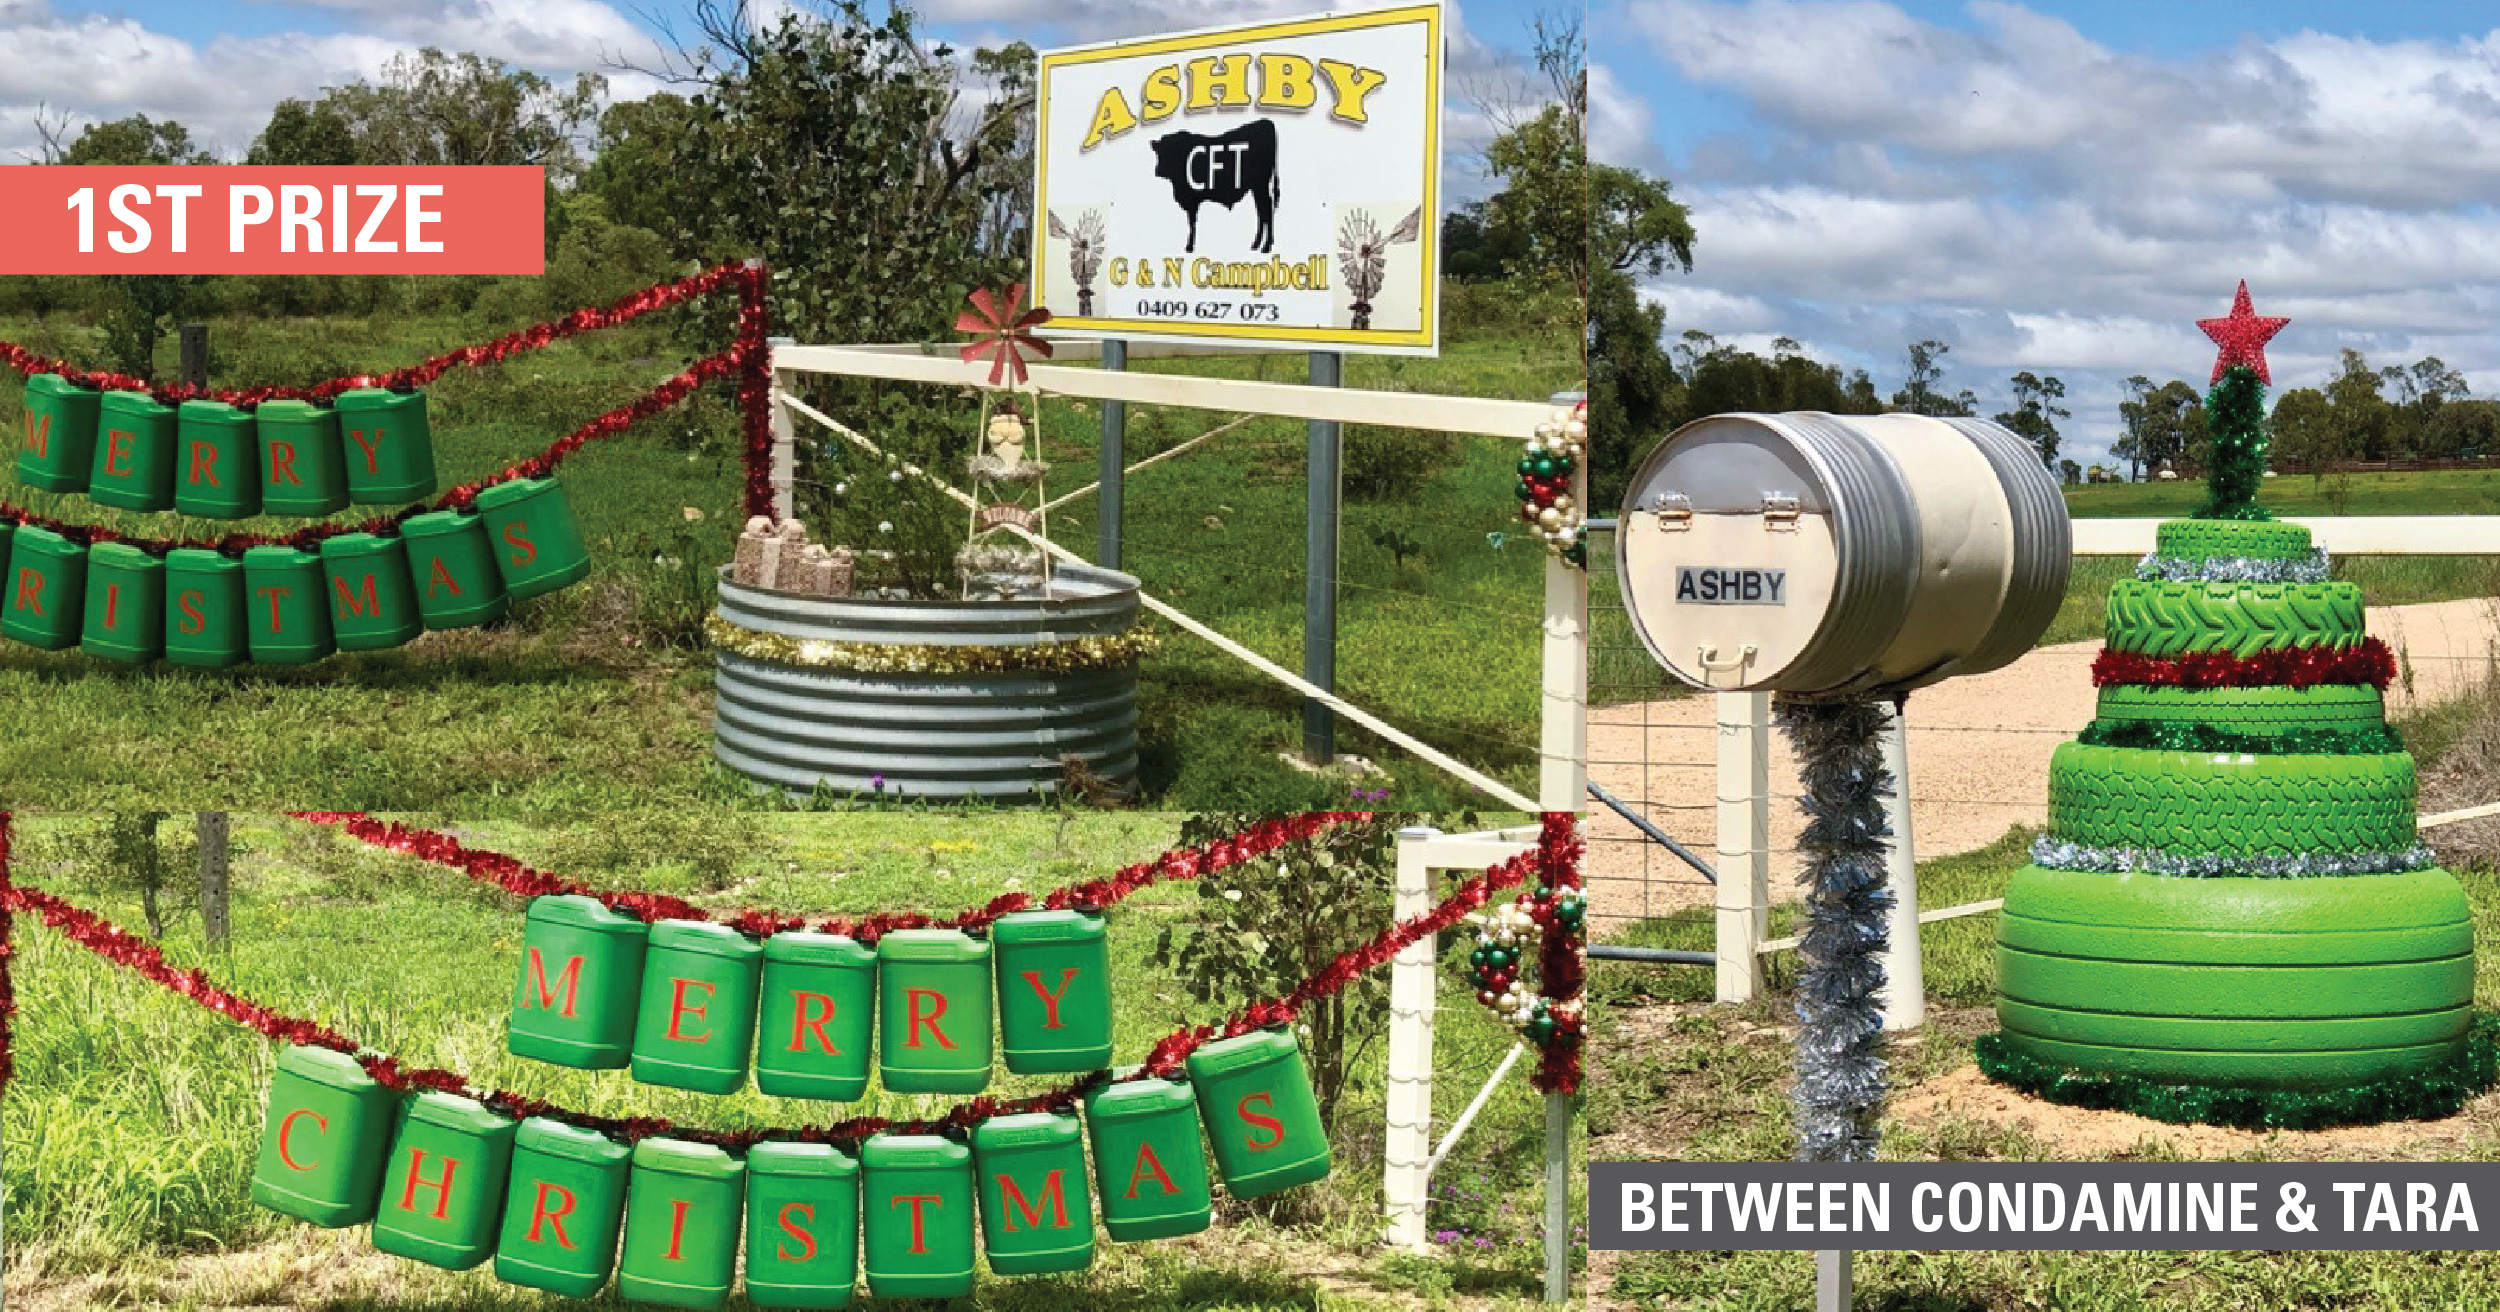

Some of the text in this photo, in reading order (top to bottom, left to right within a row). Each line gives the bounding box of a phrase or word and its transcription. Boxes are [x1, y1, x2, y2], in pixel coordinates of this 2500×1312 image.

[1082, 52, 1386, 150] ASHBY
[1185, 143, 1249, 190] CFT
[1109, 254, 1330, 297] G & N Campbell
[1137, 299, 1280, 321] 0409 627 073
[21, 408, 386, 487] MERRY
[13, 521, 537, 635] RISTMAS
[1677, 569, 1785, 601] ASHBY
[518, 947, 1080, 1055] MERRY
[277, 1090, 1286, 1263] CHRISTMAS
